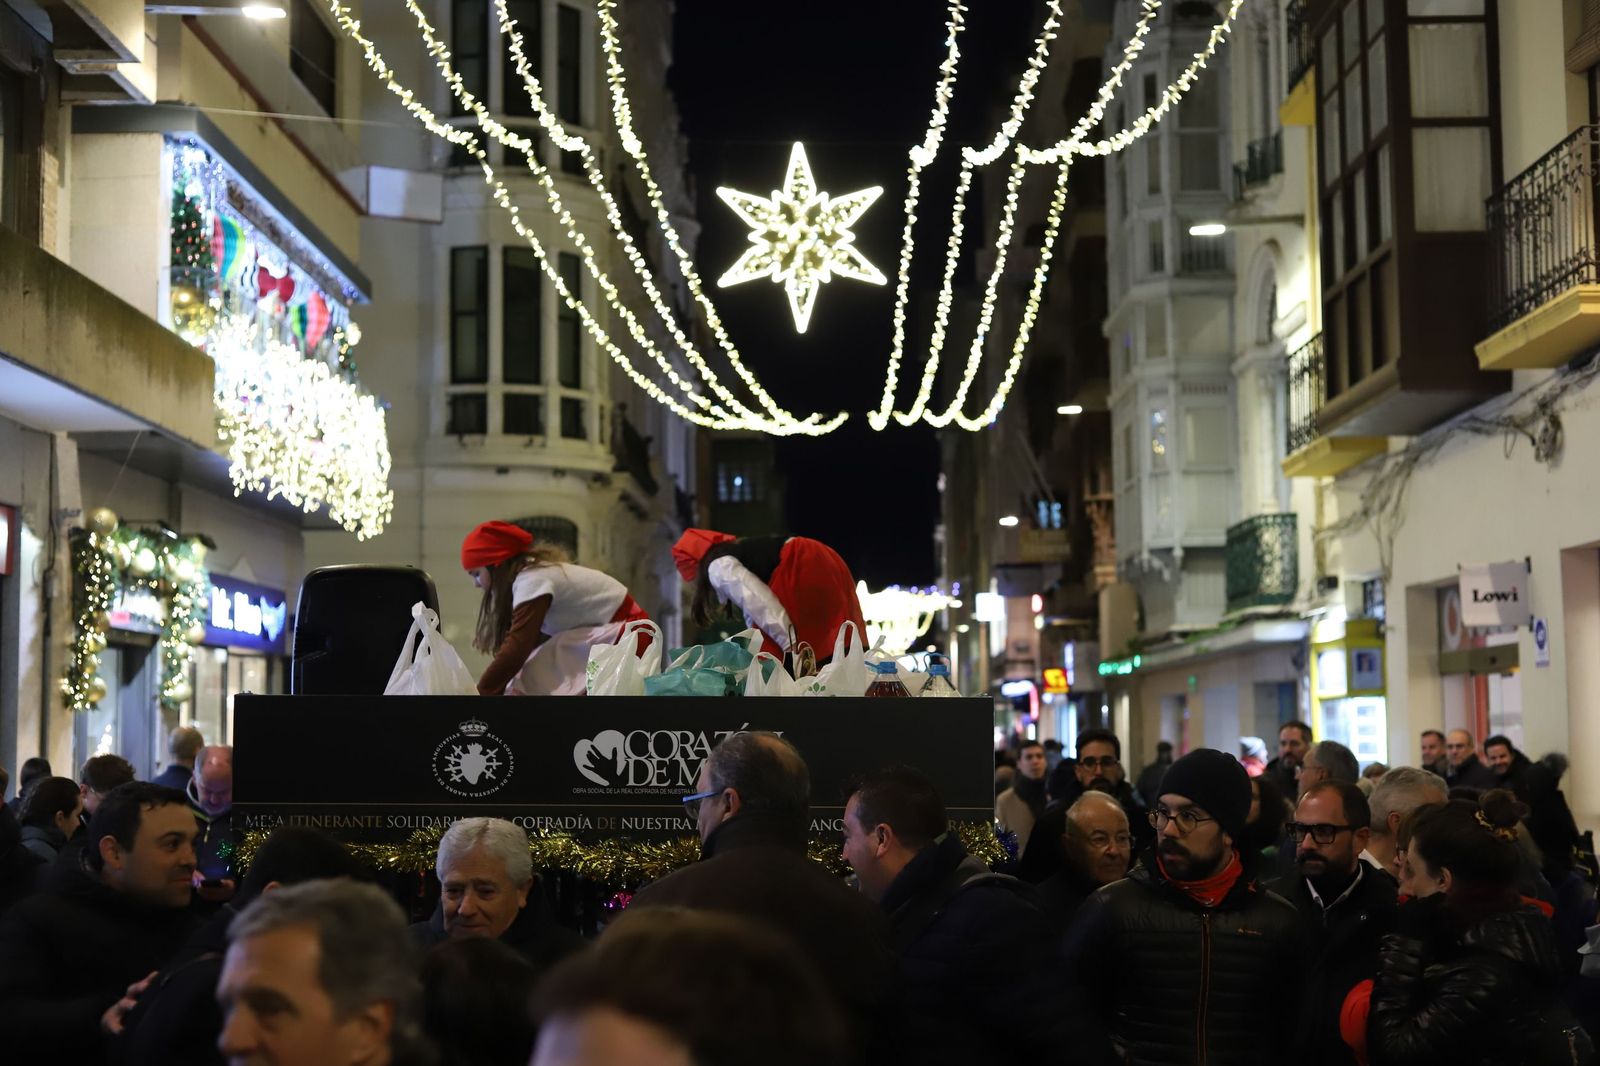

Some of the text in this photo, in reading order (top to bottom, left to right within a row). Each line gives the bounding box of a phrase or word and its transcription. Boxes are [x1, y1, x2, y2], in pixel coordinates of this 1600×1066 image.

[1473, 586, 1518, 603] Lowi
[486, 732, 503, 745] REAL
[432, 732, 461, 761] ANGUSTIAS
[625, 757, 672, 787] DE
[437, 777, 445, 786] DE
[500, 778, 508, 787] DE
[445, 785, 467, 797] MADRE
[469, 786, 500, 797] NUESTRA
[245, 815, 284, 828] MESA
[289, 815, 383, 828] ITINERANTE
[386, 815, 465, 829] SOLIDAR
[512, 813, 593, 830] COFRADÍA
[597, 816, 616, 830] DE
[621, 816, 693, 830] NUESTRA
